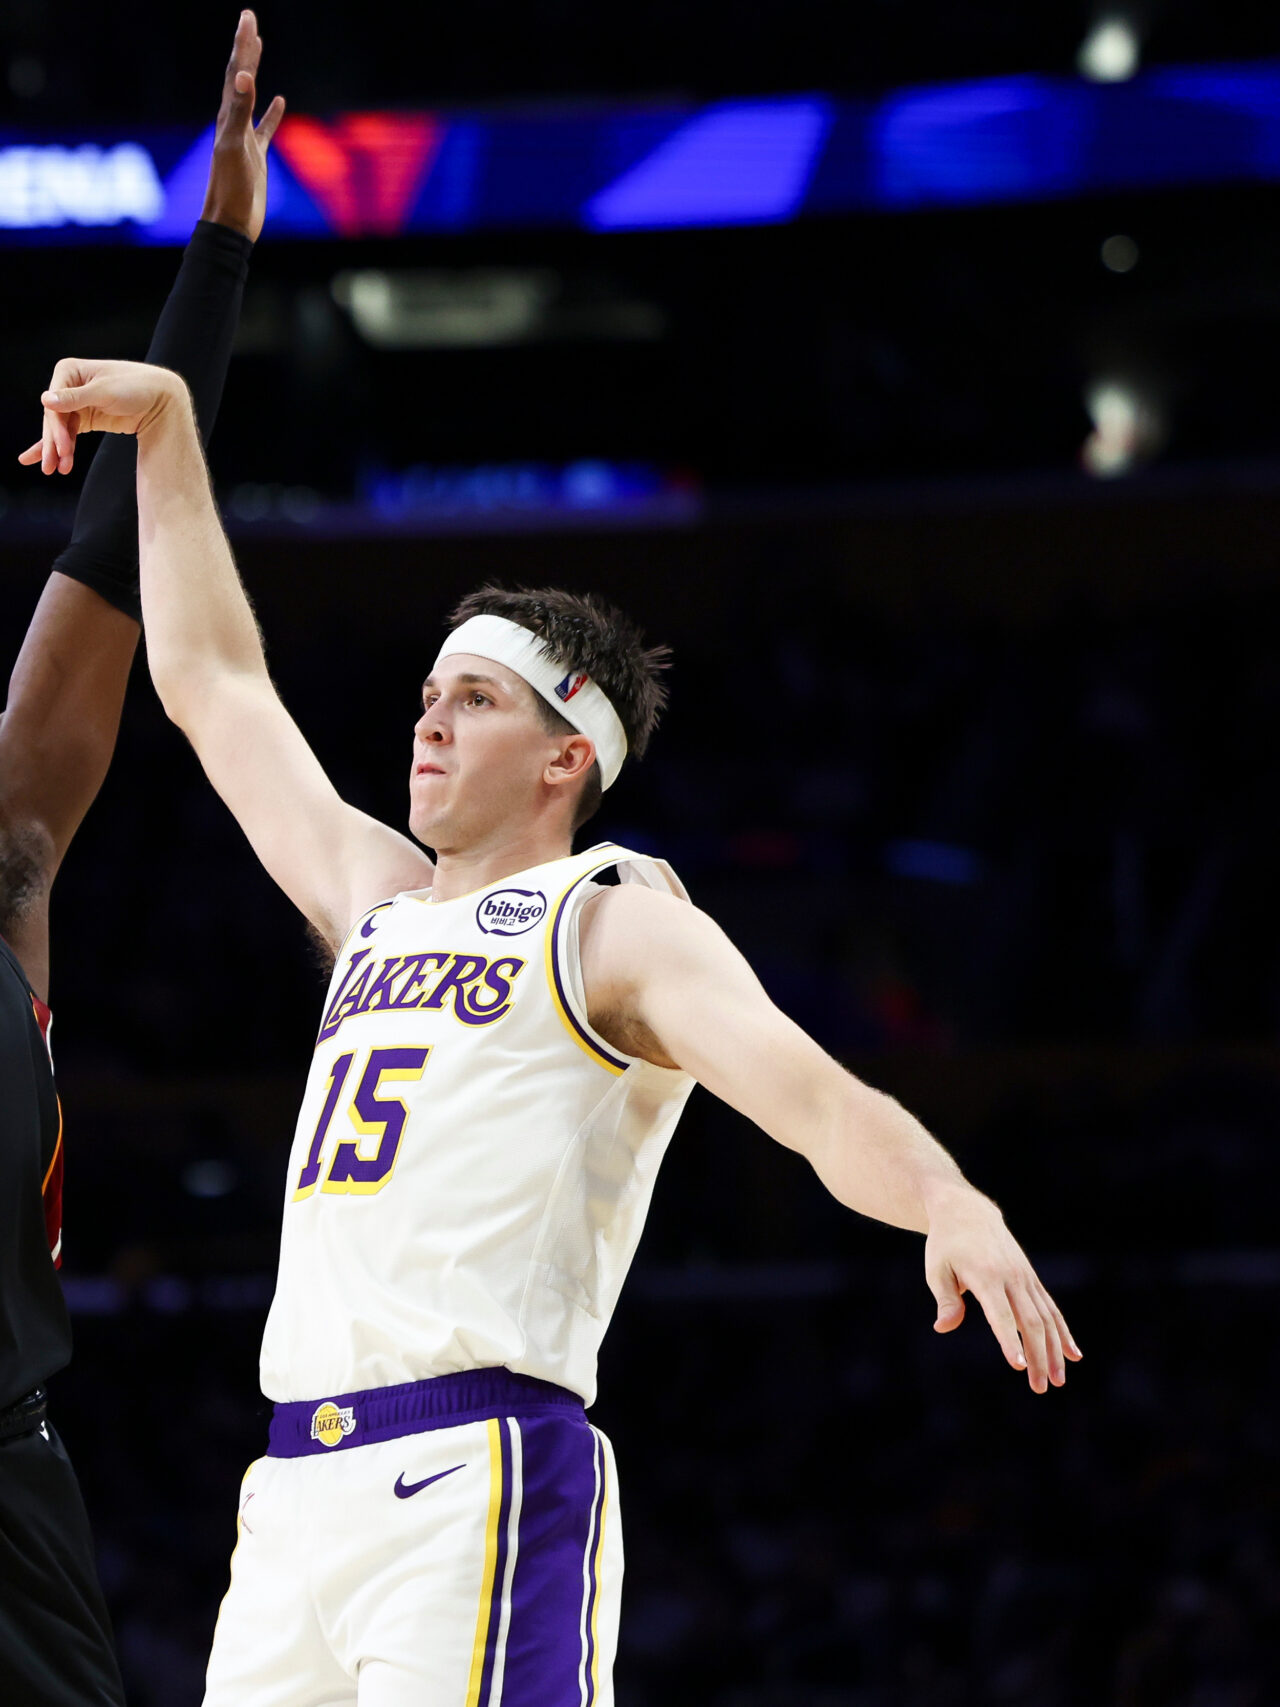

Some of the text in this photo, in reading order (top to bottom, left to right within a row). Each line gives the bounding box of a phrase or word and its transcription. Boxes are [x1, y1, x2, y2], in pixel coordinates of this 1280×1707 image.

[484, 900, 542, 923] bibigo
[315, 945, 527, 1047] LAKERS
[291, 1044, 434, 1203] 15
[313, 1415, 354, 1437] LAKERS
